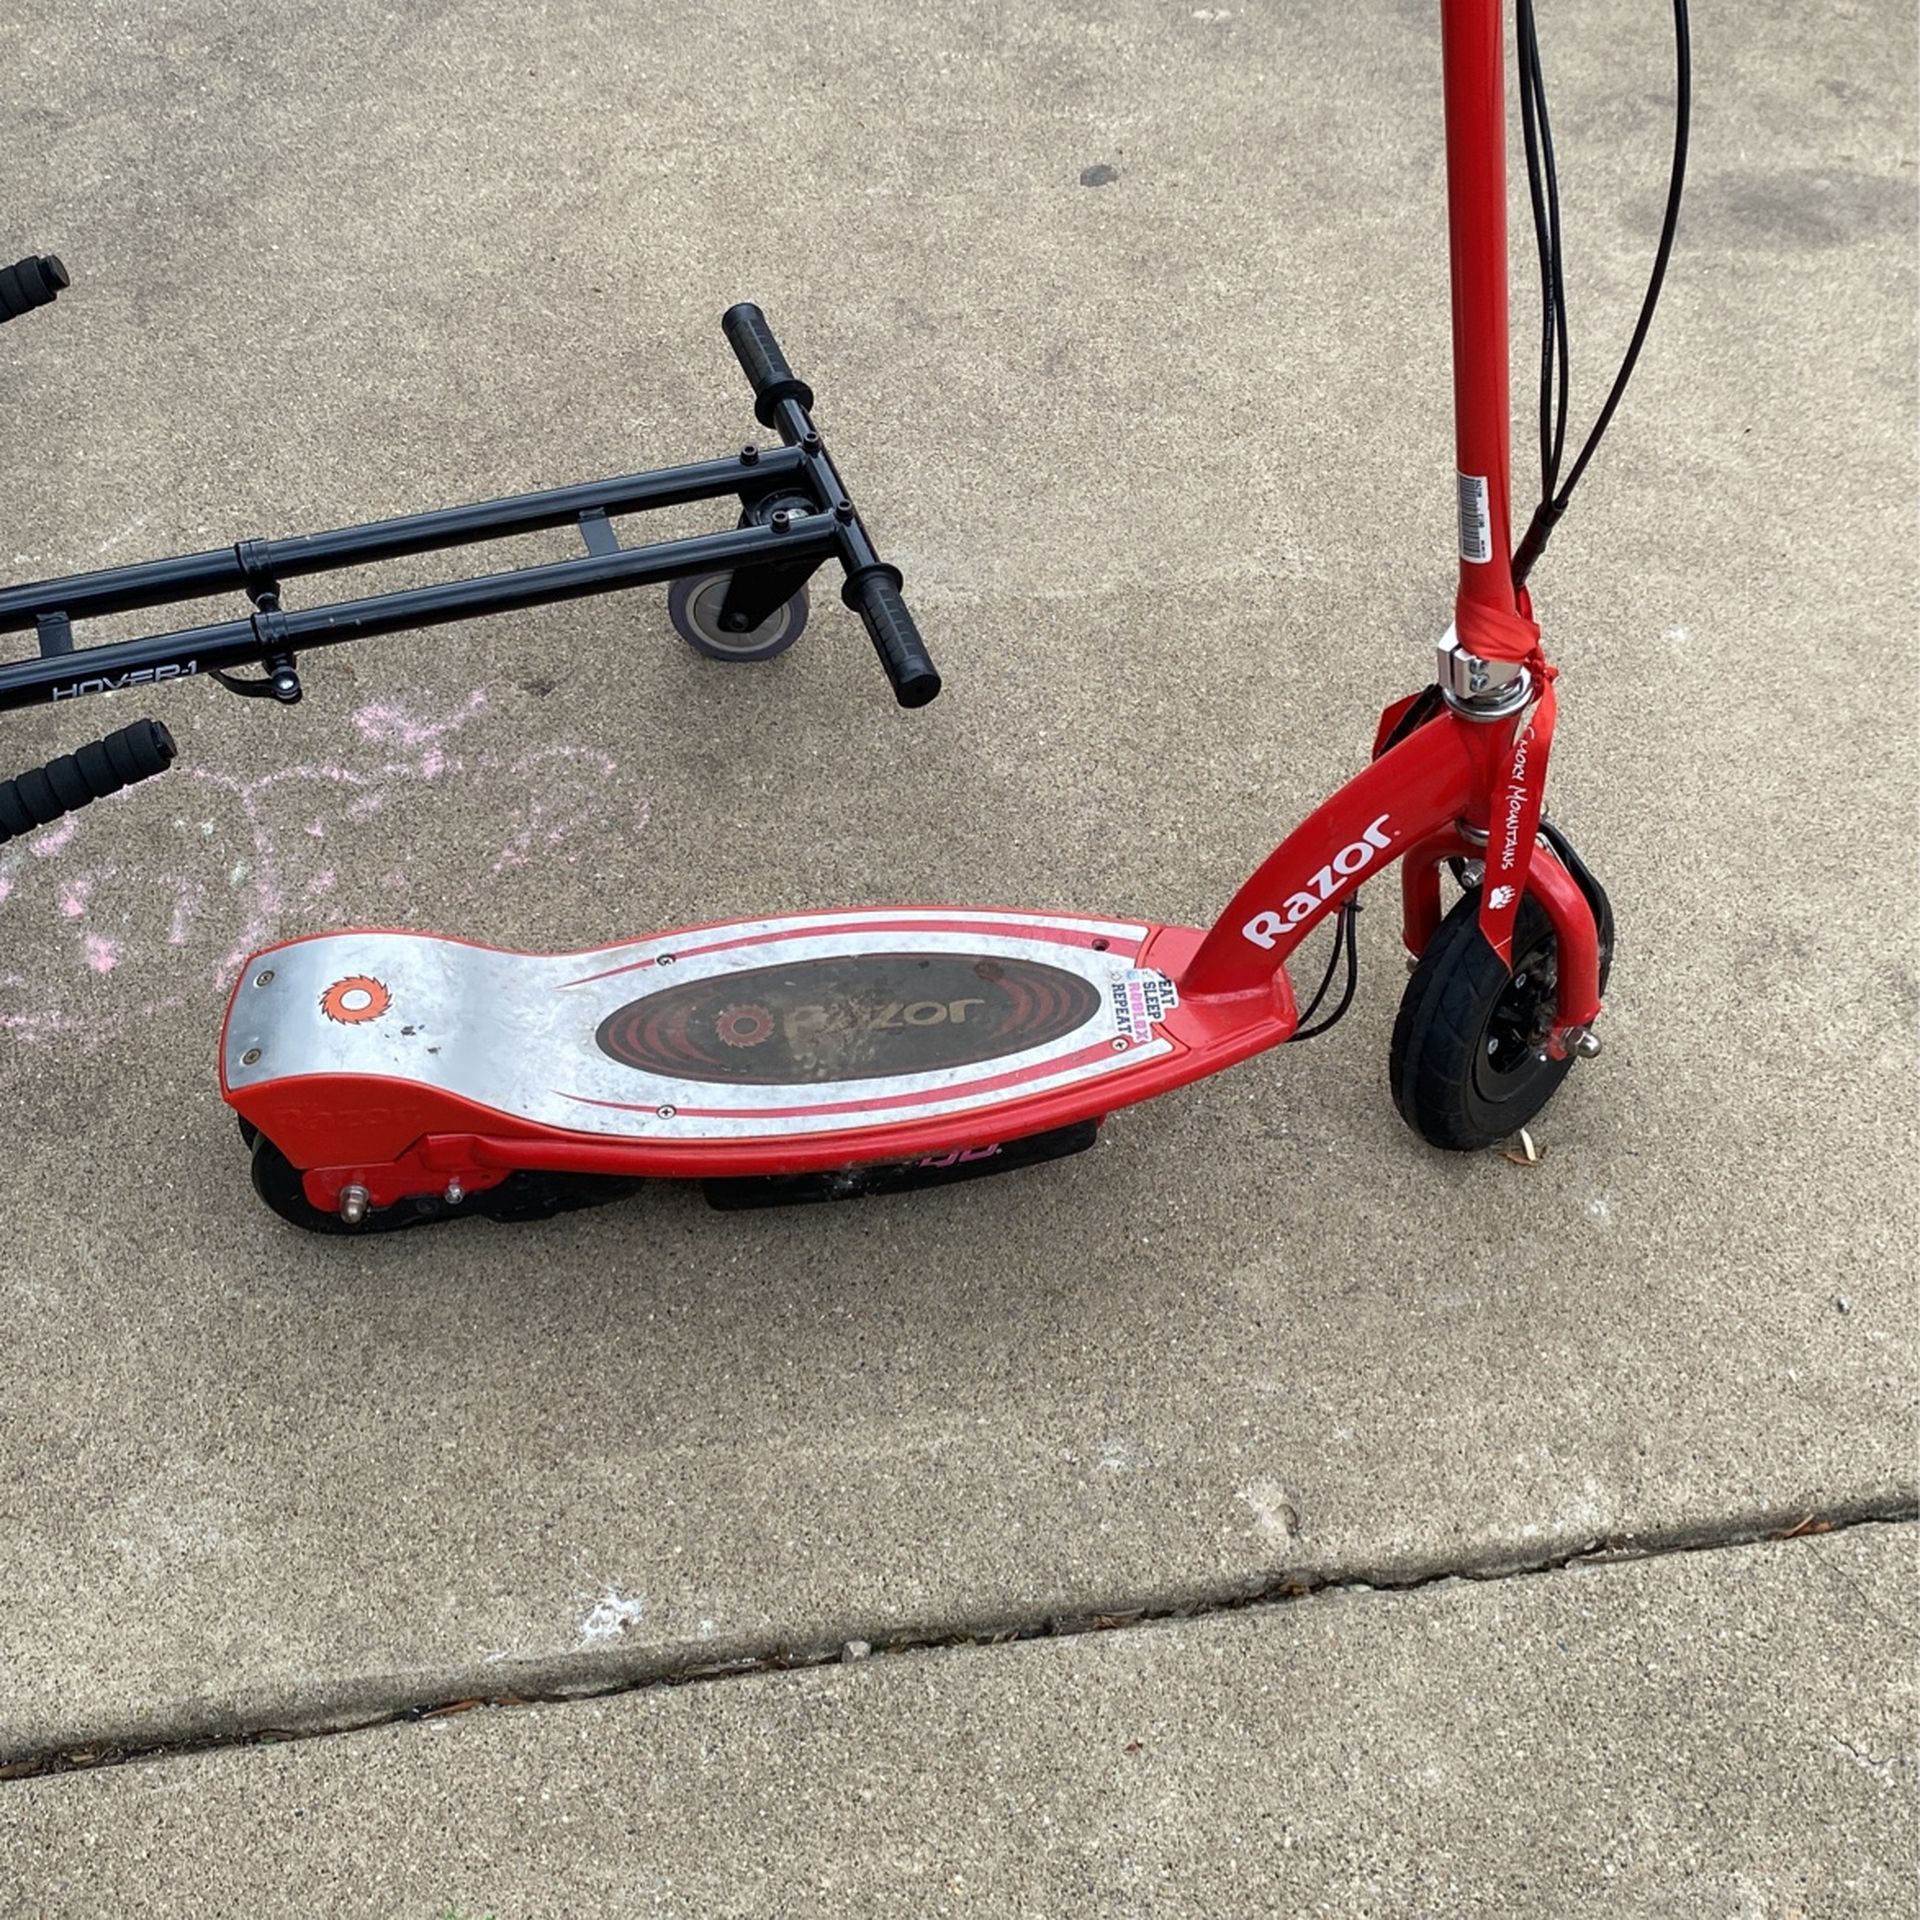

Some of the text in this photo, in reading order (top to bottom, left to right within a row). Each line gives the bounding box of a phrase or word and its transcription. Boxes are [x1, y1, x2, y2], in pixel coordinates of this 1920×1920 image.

[52, 660, 198, 701] HOVER-1
[1501, 785, 1528, 870] MOUNTAINS
[1242, 813, 1392, 950] Razor
[1111, 983, 1132, 1034] REPEAT
[1128, 981, 1149, 1040] ROBLOX
[1142, 981, 1162, 1020] SLEEP
[1158, 980, 1175, 1005] EAT
[783, 998, 985, 1049] Rzor
